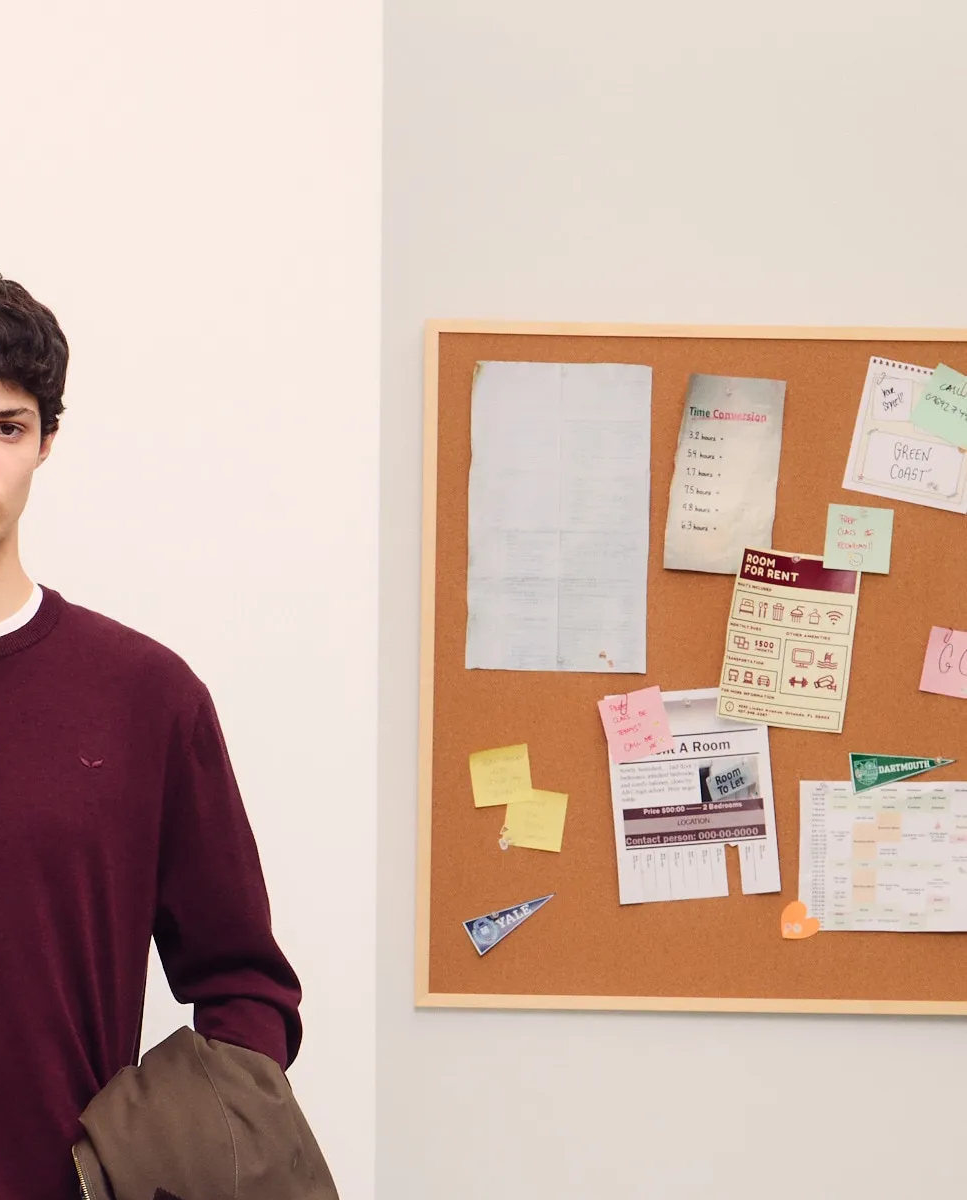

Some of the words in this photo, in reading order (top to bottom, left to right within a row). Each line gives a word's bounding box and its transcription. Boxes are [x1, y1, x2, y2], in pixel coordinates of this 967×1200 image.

[689, 406, 710, 418] Time
[713, 409, 767, 423] Conversion
[701, 434, 716, 442] hours
[700, 452, 715, 460] hours
[894, 442, 933, 461] GREEN
[698, 469, 713, 478] hours
[890, 464, 932, 482] COAST
[696, 487, 712, 496] hours
[695, 505, 710, 514] hours
[693, 523, 708, 532] hours
[746, 553, 776, 568] ROOM
[744, 564, 764, 577] FOR
[767, 570, 799, 582] RENT
[754, 640, 774, 650] $500
[679, 742, 688, 753] A
[693, 741, 730, 752] Room
[878, 760, 930, 774] DARTMOUTH
[714, 766, 741, 786] Room
[717, 786, 729, 796] To
[732, 776, 746, 791] Let
[643, 807, 660, 815] Price
[662, 805, 685, 814] $00:00
[709, 802, 742, 810] Bedrooms
[677, 817, 710, 826] LOCATION
[626, 835, 662, 846] Contact
[664, 833, 696, 844] person:
[698, 826, 758, 840] 000-00-0000
[494, 903, 532, 930] YALE
